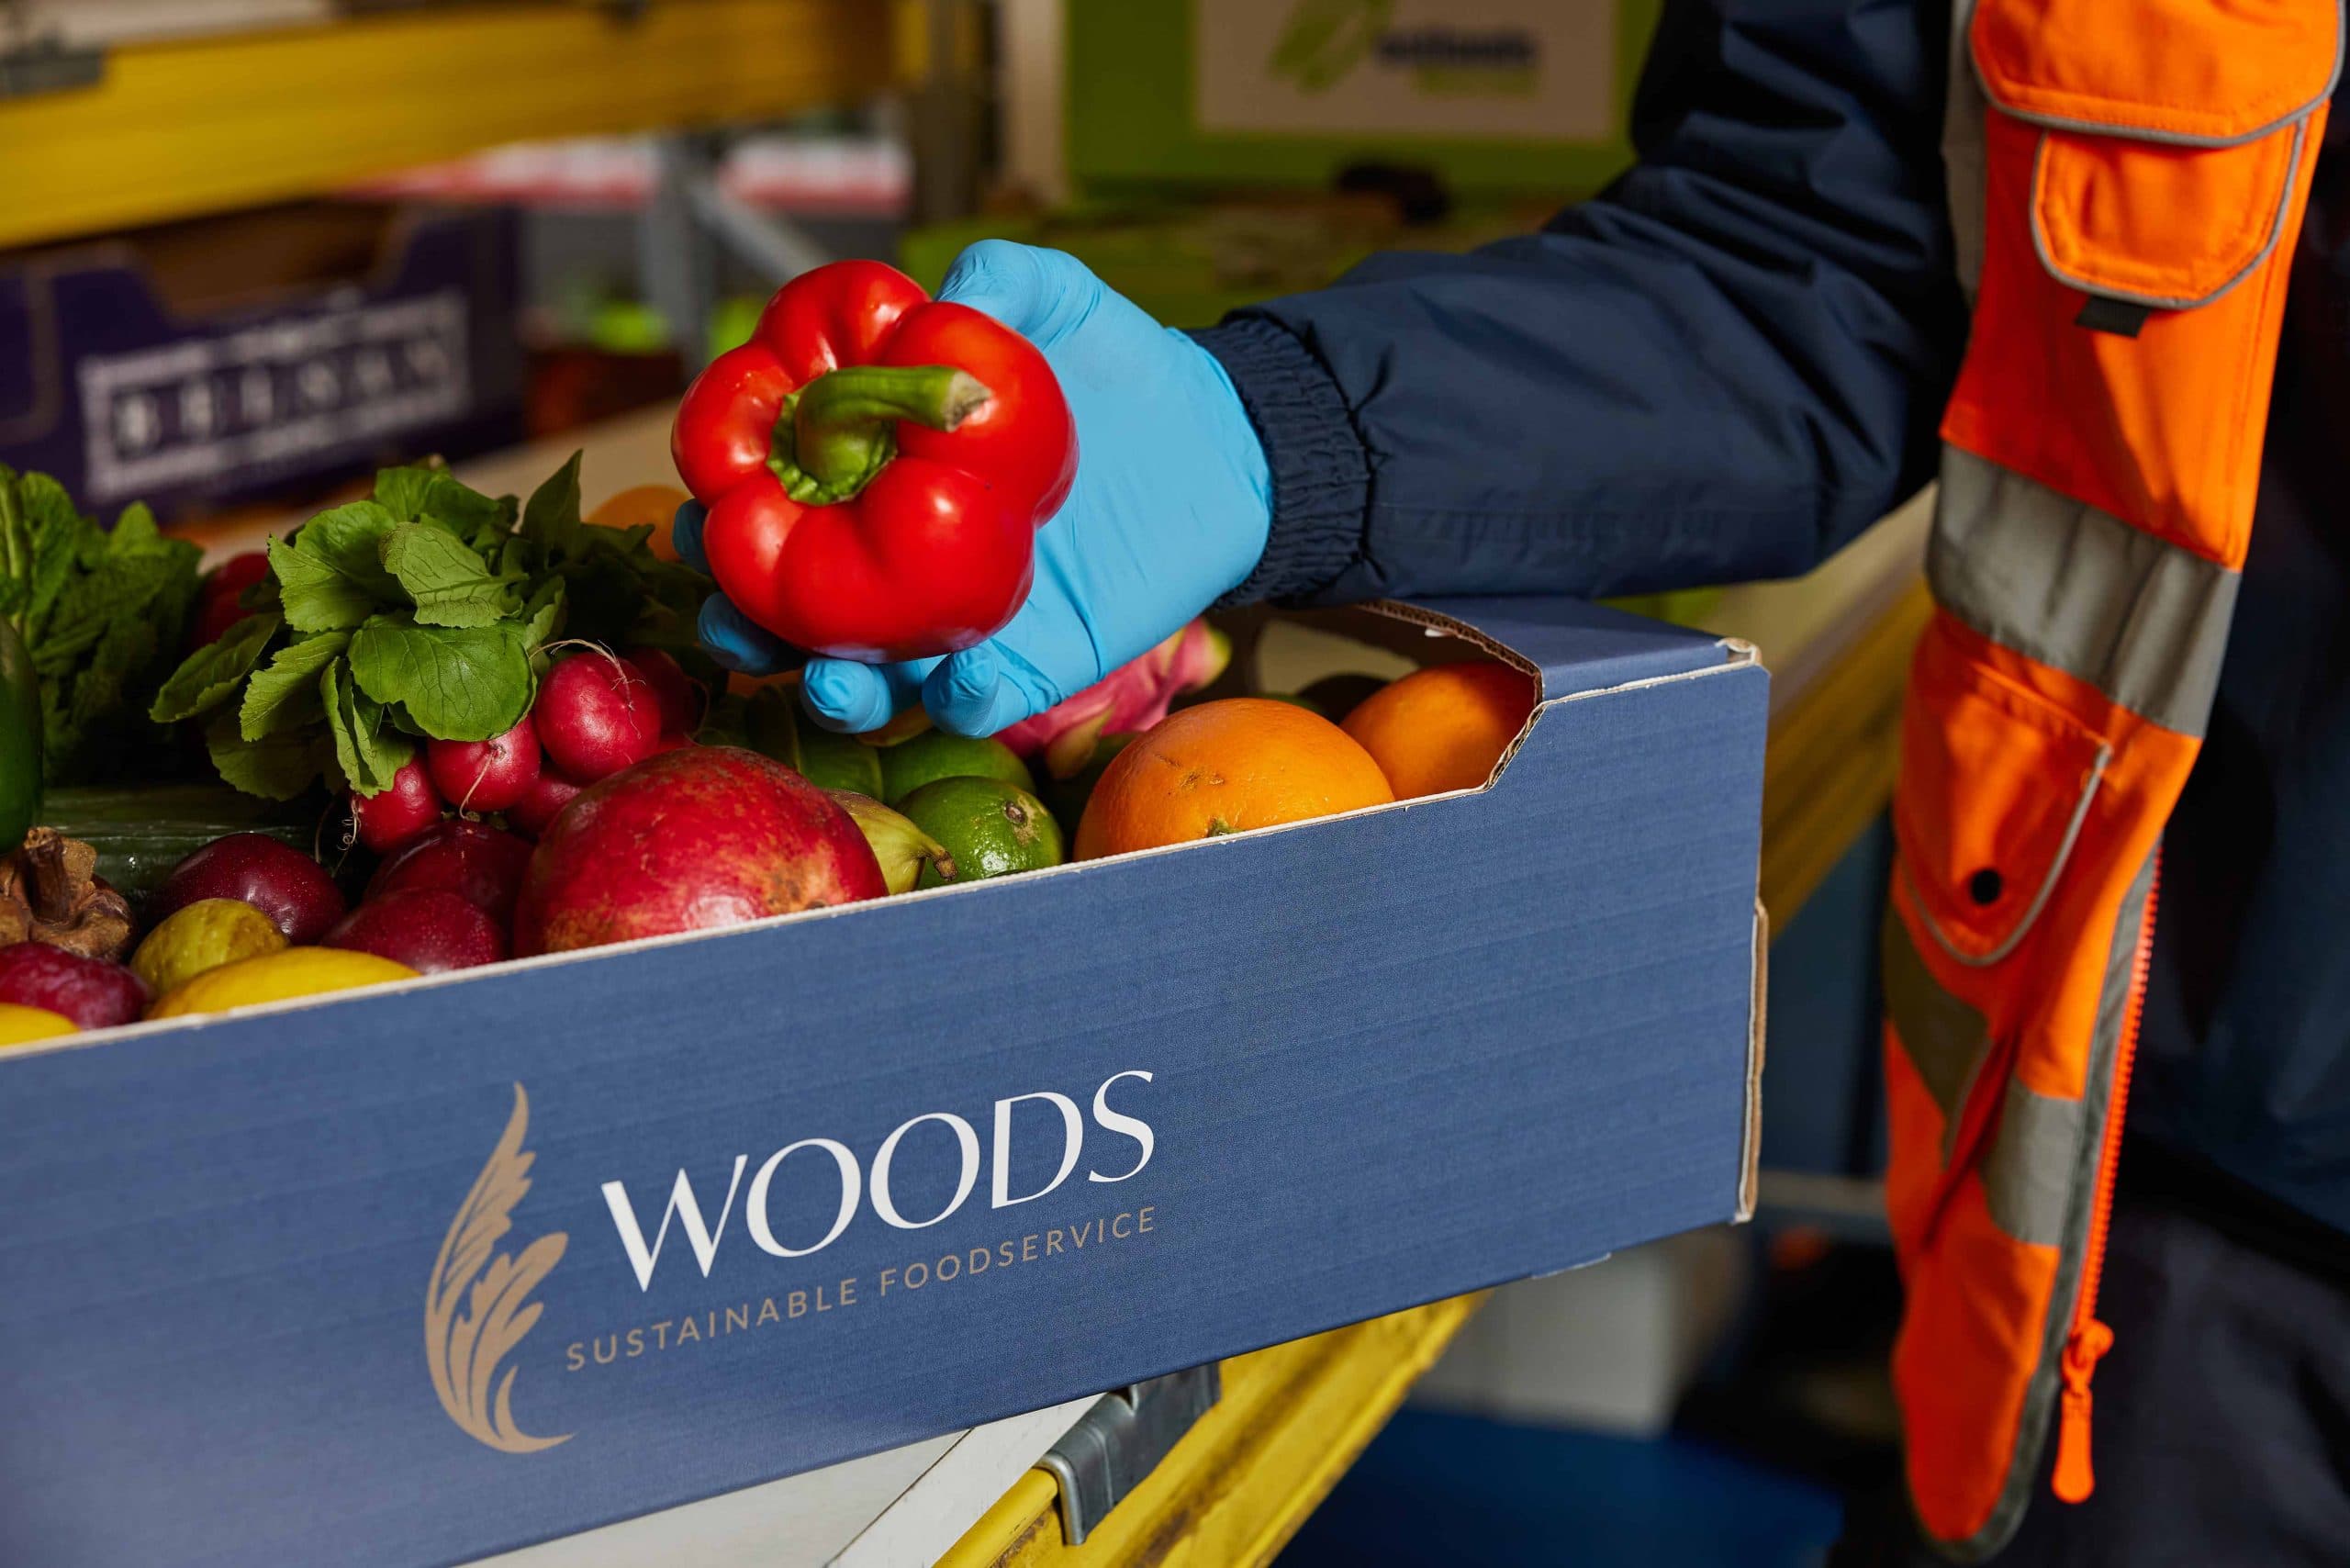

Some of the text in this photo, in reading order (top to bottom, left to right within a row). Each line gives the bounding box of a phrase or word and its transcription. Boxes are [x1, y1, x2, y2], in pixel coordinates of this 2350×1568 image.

[602, 1070, 1154, 1291] WOODS
[566, 1206, 1157, 1372] SUSTAINABLE FOODSERVICE
